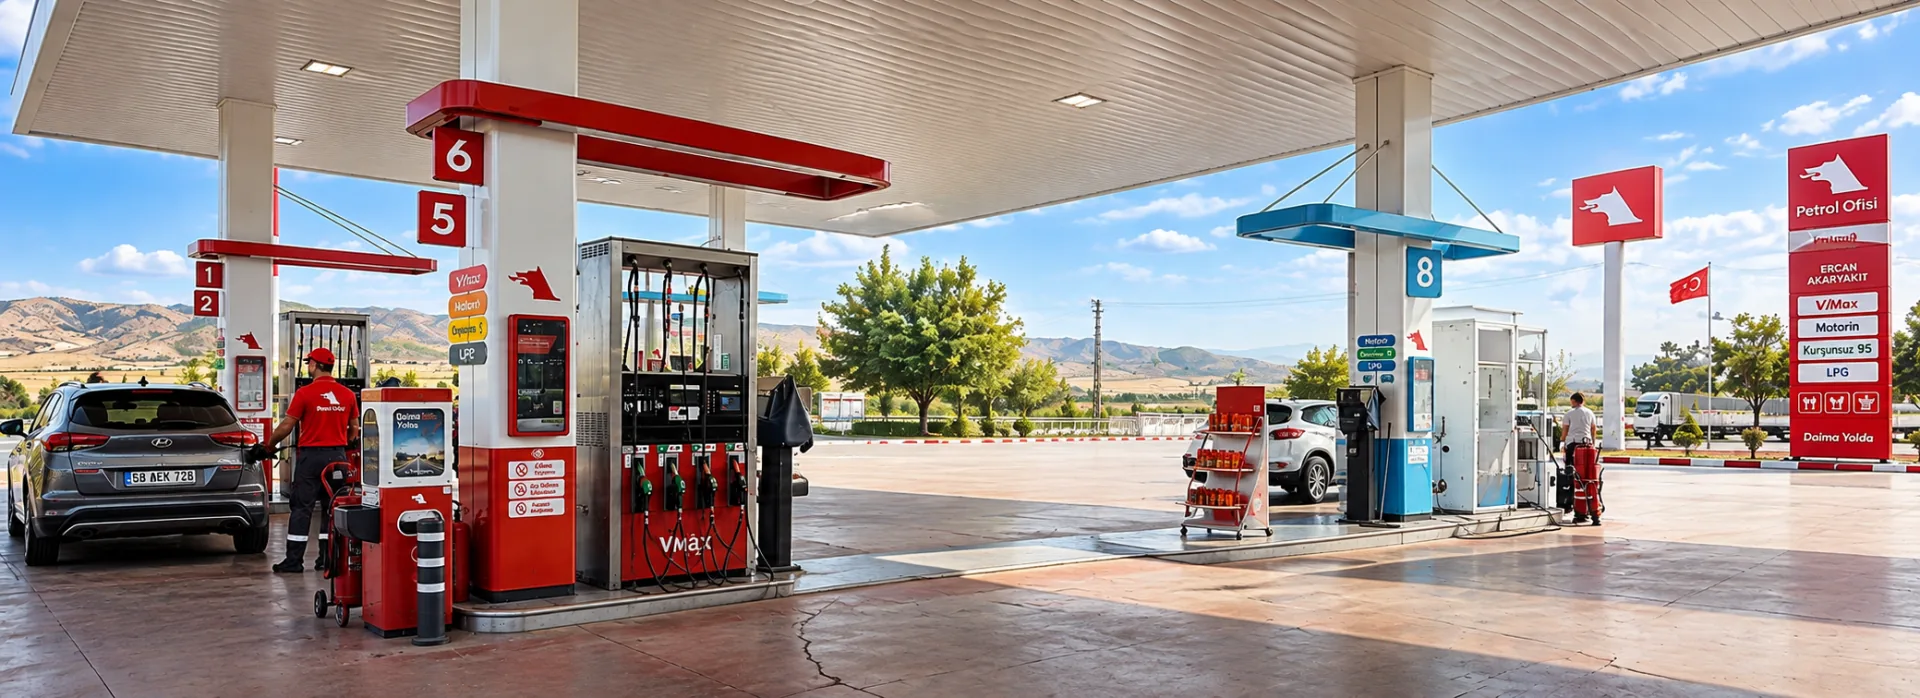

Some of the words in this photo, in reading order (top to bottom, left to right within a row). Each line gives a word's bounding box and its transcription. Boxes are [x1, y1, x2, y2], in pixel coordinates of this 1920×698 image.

[446, 138, 472, 172] 6
[1796, 201, 1839, 218] Petrol
[1842, 197, 1878, 212] Ofisi
[430, 202, 455, 235] 5
[204, 266, 213, 284] 1
[1416, 256, 1434, 288] 8
[1820, 263, 1858, 274] ERCAN
[1807, 272, 1868, 286] AKARYAKIT
[200, 295, 213, 312] 2
[1815, 298, 1858, 311] V/Max
[1815, 321, 1860, 333] Motorin
[1803, 345, 1854, 357] Kurşunsuz
[1857, 343, 1873, 354] 95
[1826, 367, 1849, 378] LPG
[1803, 432, 1840, 442] Daima
[1842, 432, 1874, 443] Yolda
